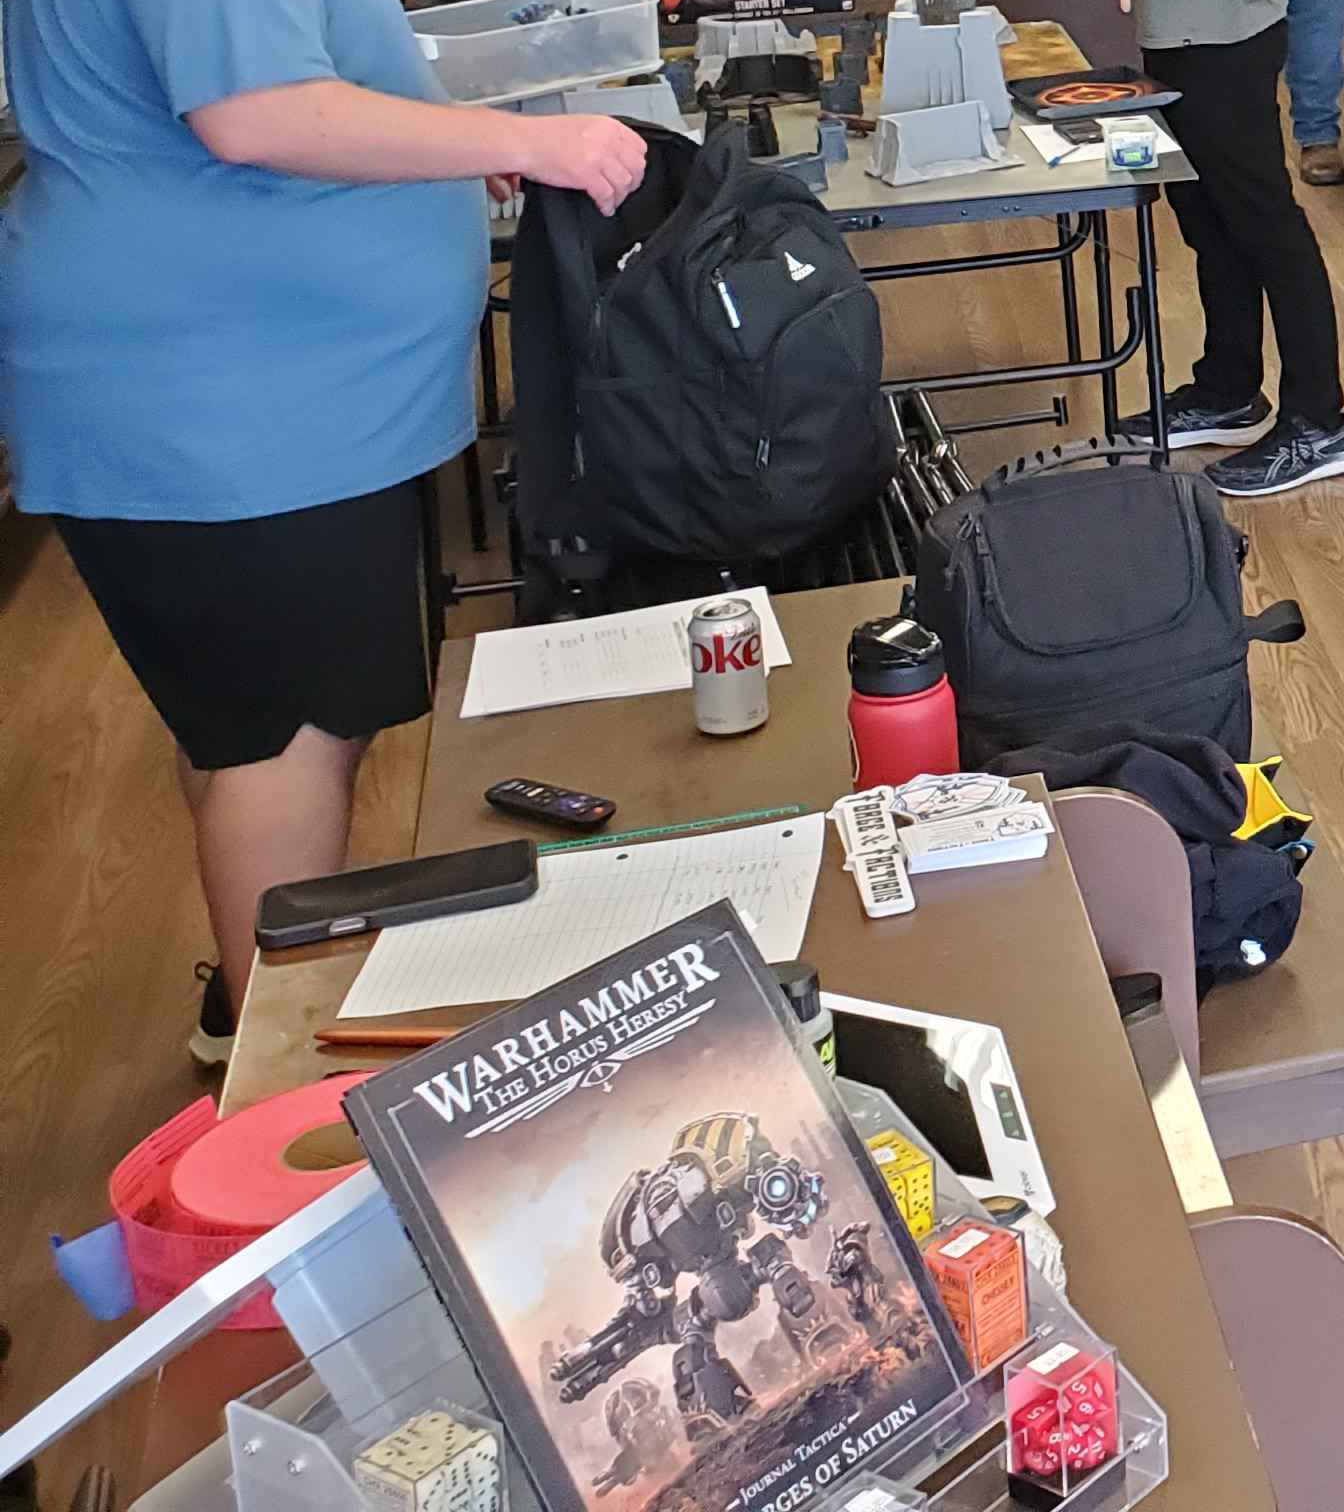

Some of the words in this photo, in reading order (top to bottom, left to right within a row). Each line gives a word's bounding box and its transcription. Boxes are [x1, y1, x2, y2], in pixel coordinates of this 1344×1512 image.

[735, 0, 769, 11] STARTER
[856, 843, 904, 904] FACTIONS
[413, 941, 721, 1123] WARHAMMER
[474, 1077, 530, 1116] THE
[526, 1035, 609, 1088] HORUS
[606, 990, 690, 1046] HERESY
[739, 1458, 797, 1506] JOURNAL
[794, 1421, 848, 1463] TACTICA
[815, 1455, 842, 1486] OF
[841, 1398, 920, 1465] SATURN
